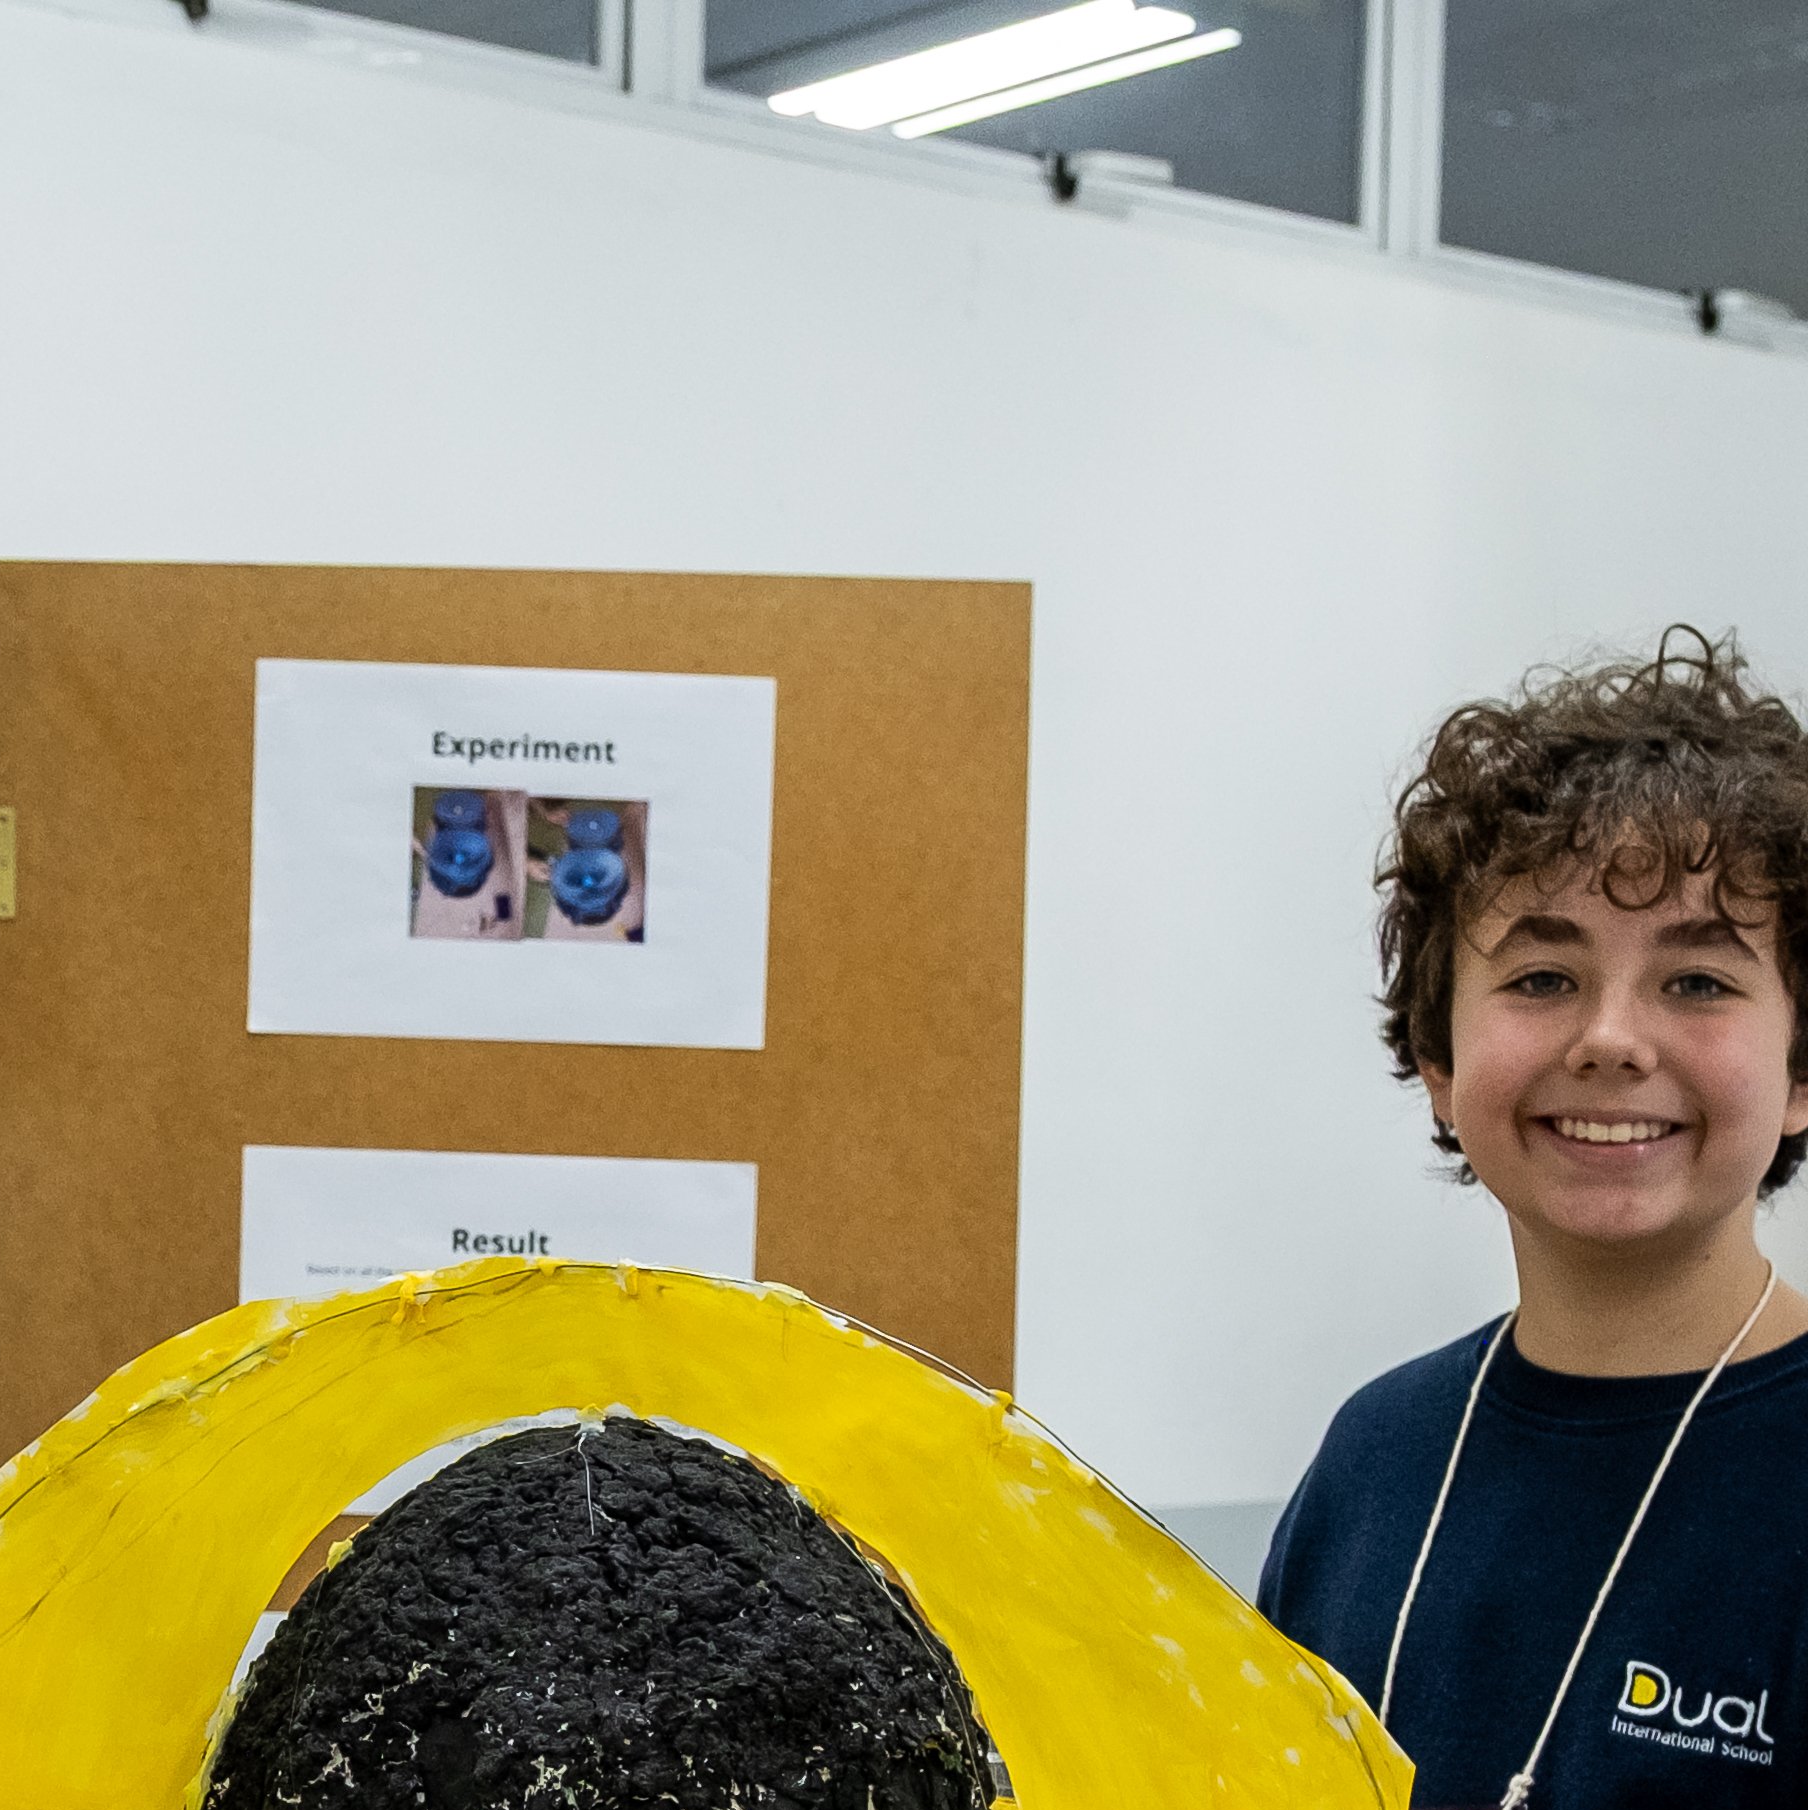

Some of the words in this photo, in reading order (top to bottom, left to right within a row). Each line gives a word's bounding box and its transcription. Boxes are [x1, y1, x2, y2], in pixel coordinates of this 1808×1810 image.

[432, 730, 618, 767] Experiment
[451, 1228, 552, 1256] Result
[1617, 1660, 1774, 1744] Dual
[1611, 1714, 1715, 1754] International
[1721, 1740, 1773, 1766] School
